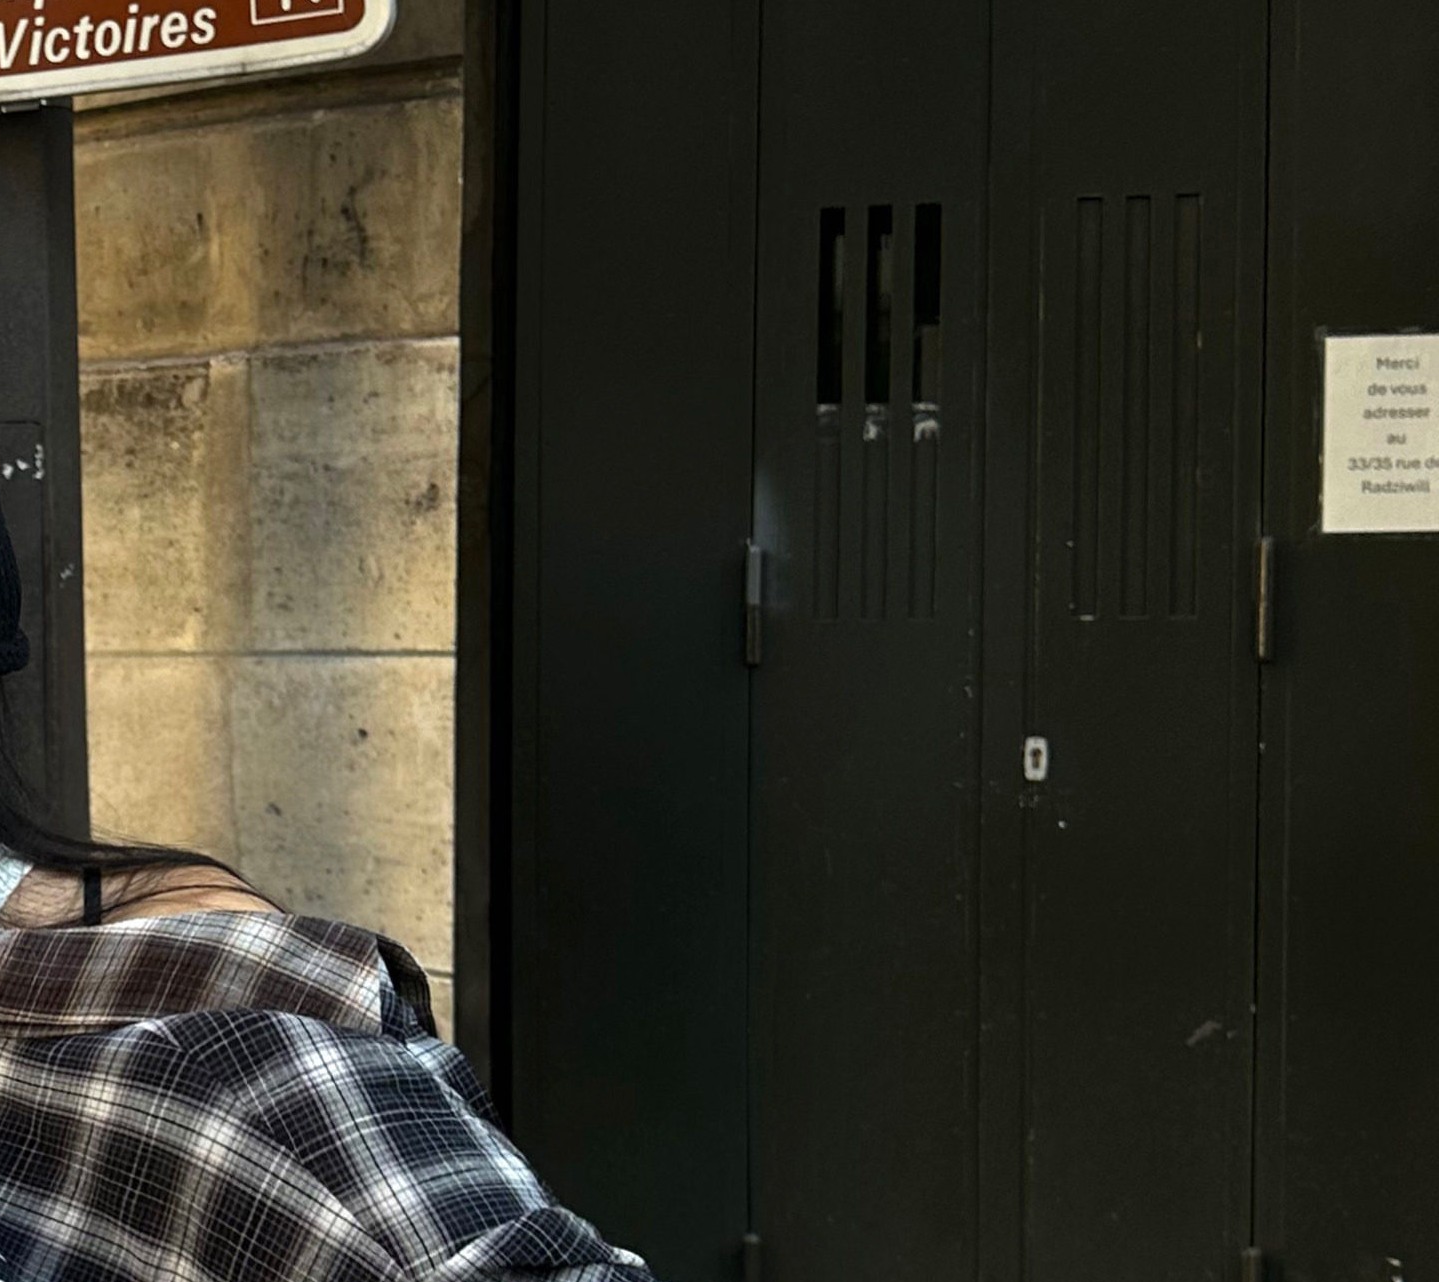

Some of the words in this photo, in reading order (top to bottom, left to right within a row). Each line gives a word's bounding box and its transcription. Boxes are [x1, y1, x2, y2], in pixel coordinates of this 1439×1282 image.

[1376, 356, 1420, 370] Merci
[1367, 383, 1388, 396] de
[1390, 384, 1428, 396] vous
[1363, 407, 1430, 420] adresser
[1387, 433, 1407, 445] au
[1395, 458, 1422, 470] rue
